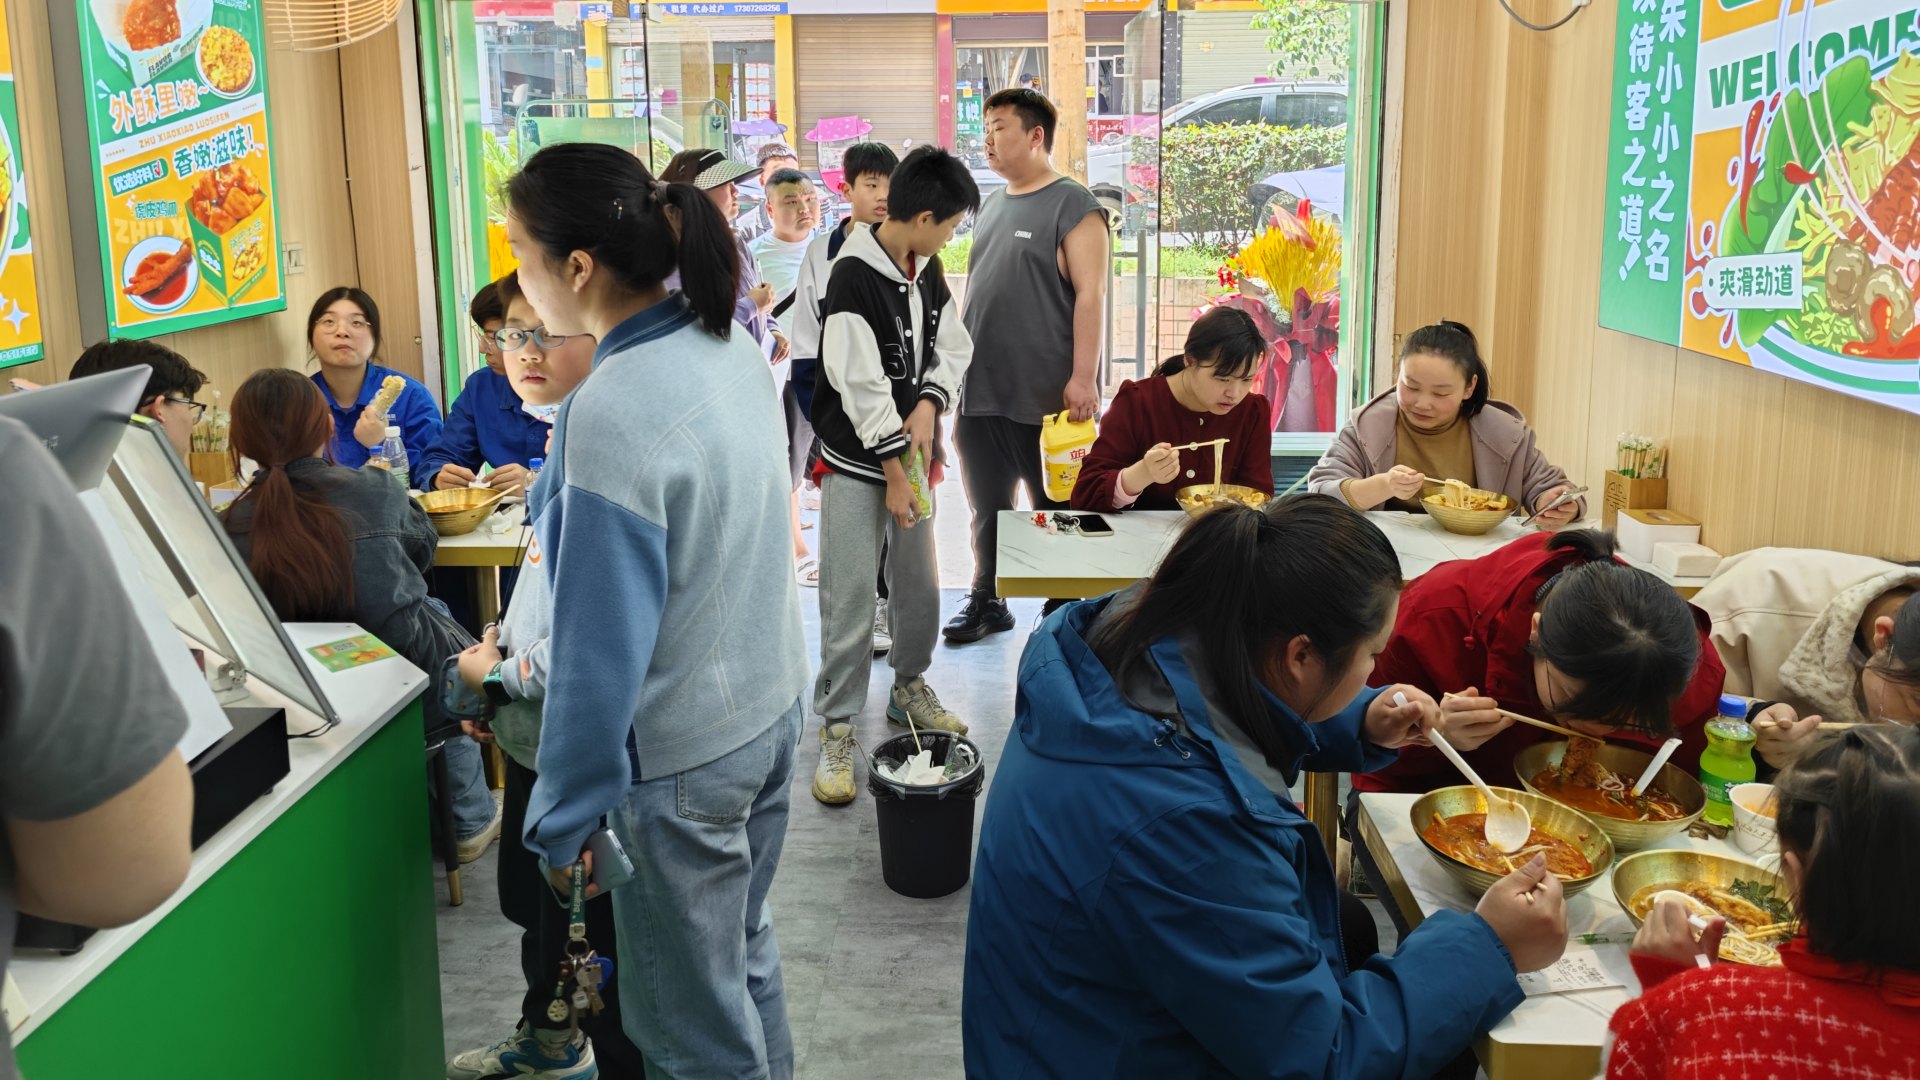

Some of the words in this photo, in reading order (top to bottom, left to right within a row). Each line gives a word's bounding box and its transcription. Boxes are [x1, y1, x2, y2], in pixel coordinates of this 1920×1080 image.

[671, 4, 688, 14] 租赁
[692, 4, 725, 13] 代办过户
[138, 136, 156, 148] ZHU
[158, 125, 194, 143] XIAOXIAO
[196, 112, 230, 130] LUOSIFEN
[1645, 0, 1686, 281] 朱小小之名
[174, 124, 254, 178] 香嫩滋味!
[113, 165, 153, 193] 优选好料
[1719, 264, 1794, 298] 爽滑劲道
[1070, 448, 1086, 459] 立白
